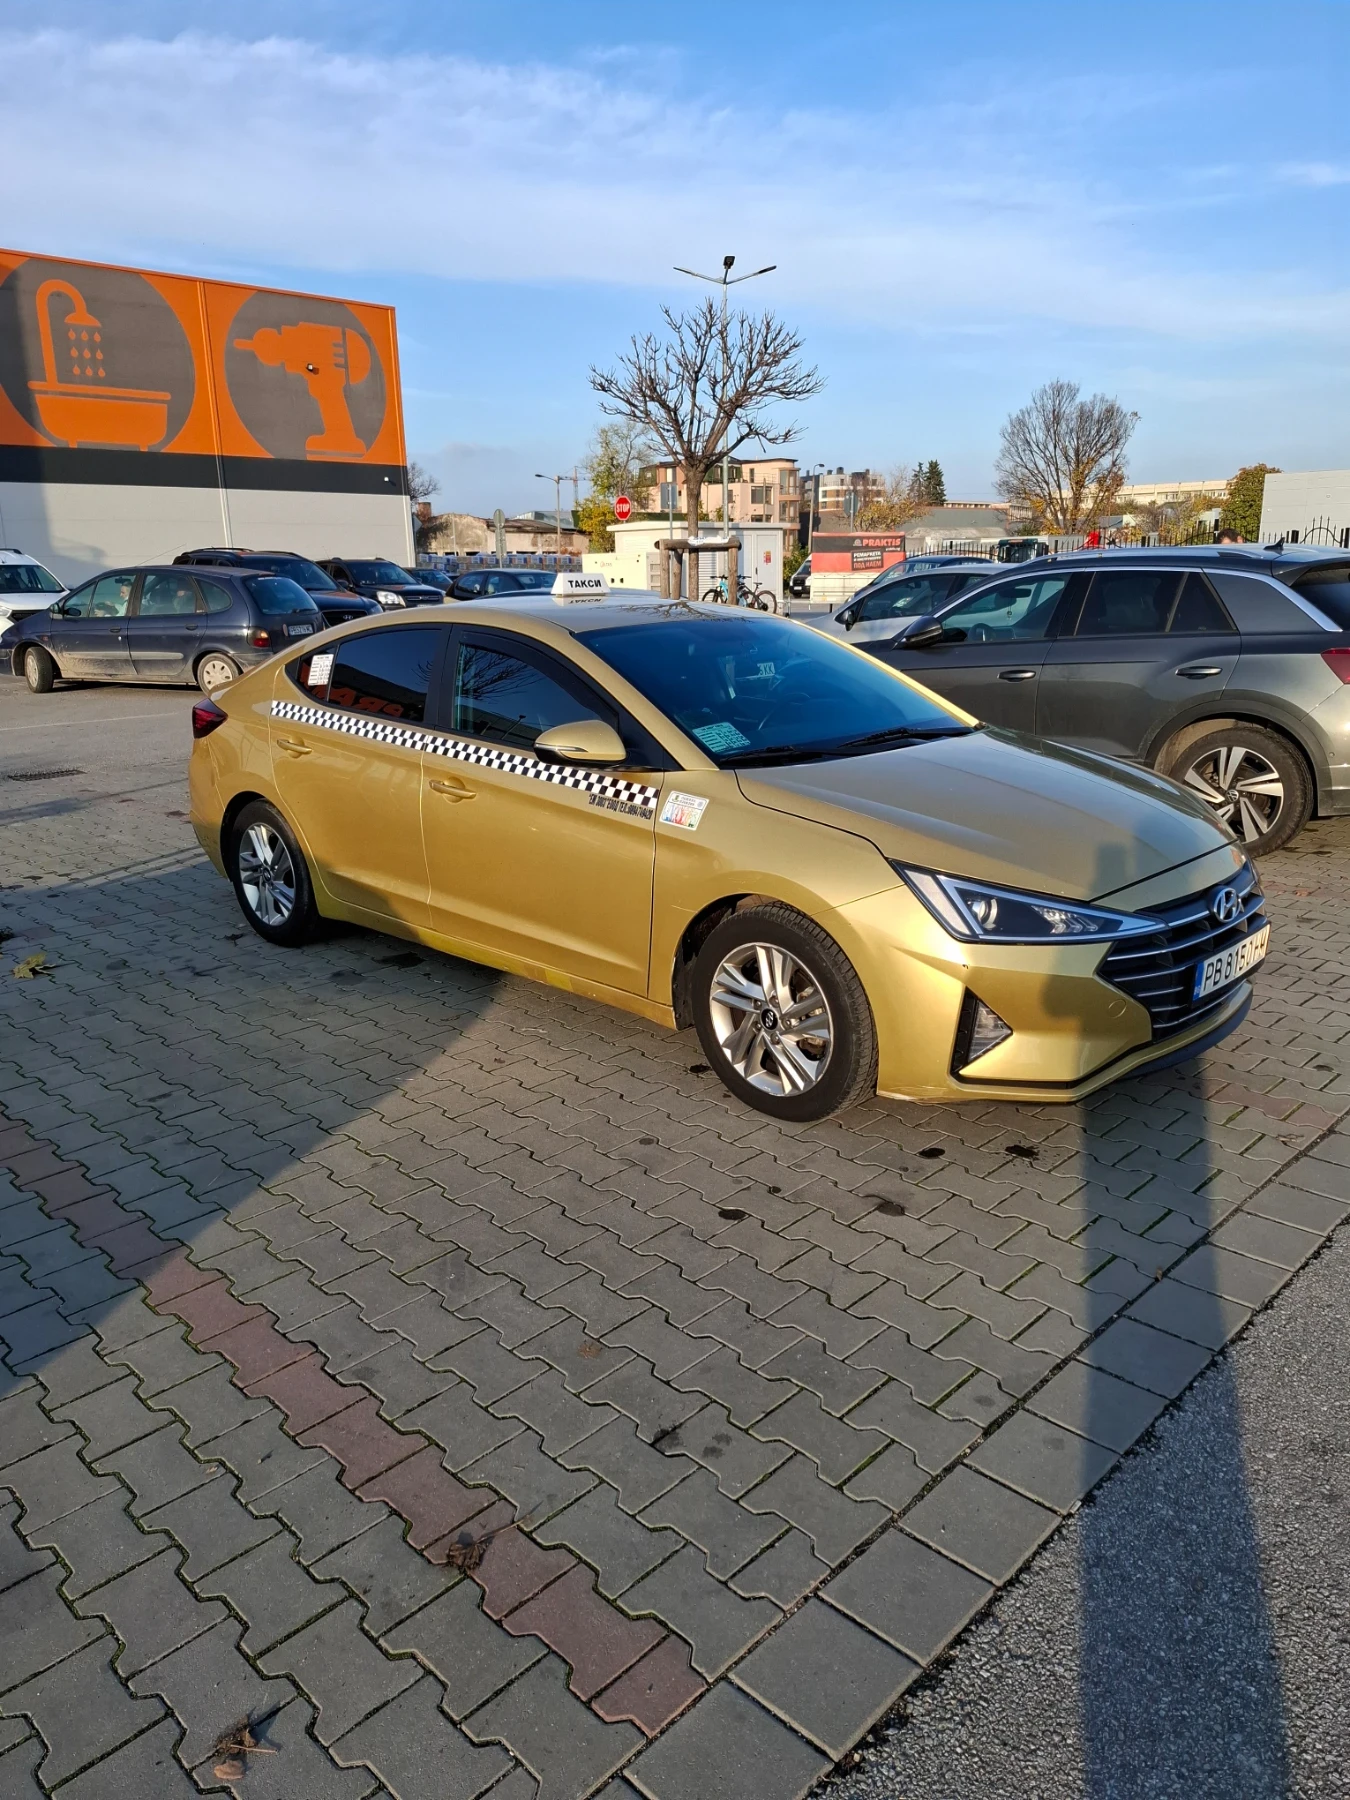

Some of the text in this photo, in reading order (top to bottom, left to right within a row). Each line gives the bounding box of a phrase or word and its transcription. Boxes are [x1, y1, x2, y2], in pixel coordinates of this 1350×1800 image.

[616, 504, 630, 512] STOP
[862, 538, 901, 547] PRAKTIS
[568, 580, 602, 588] ТАКСИ
[1204, 957, 1222, 991] PB
